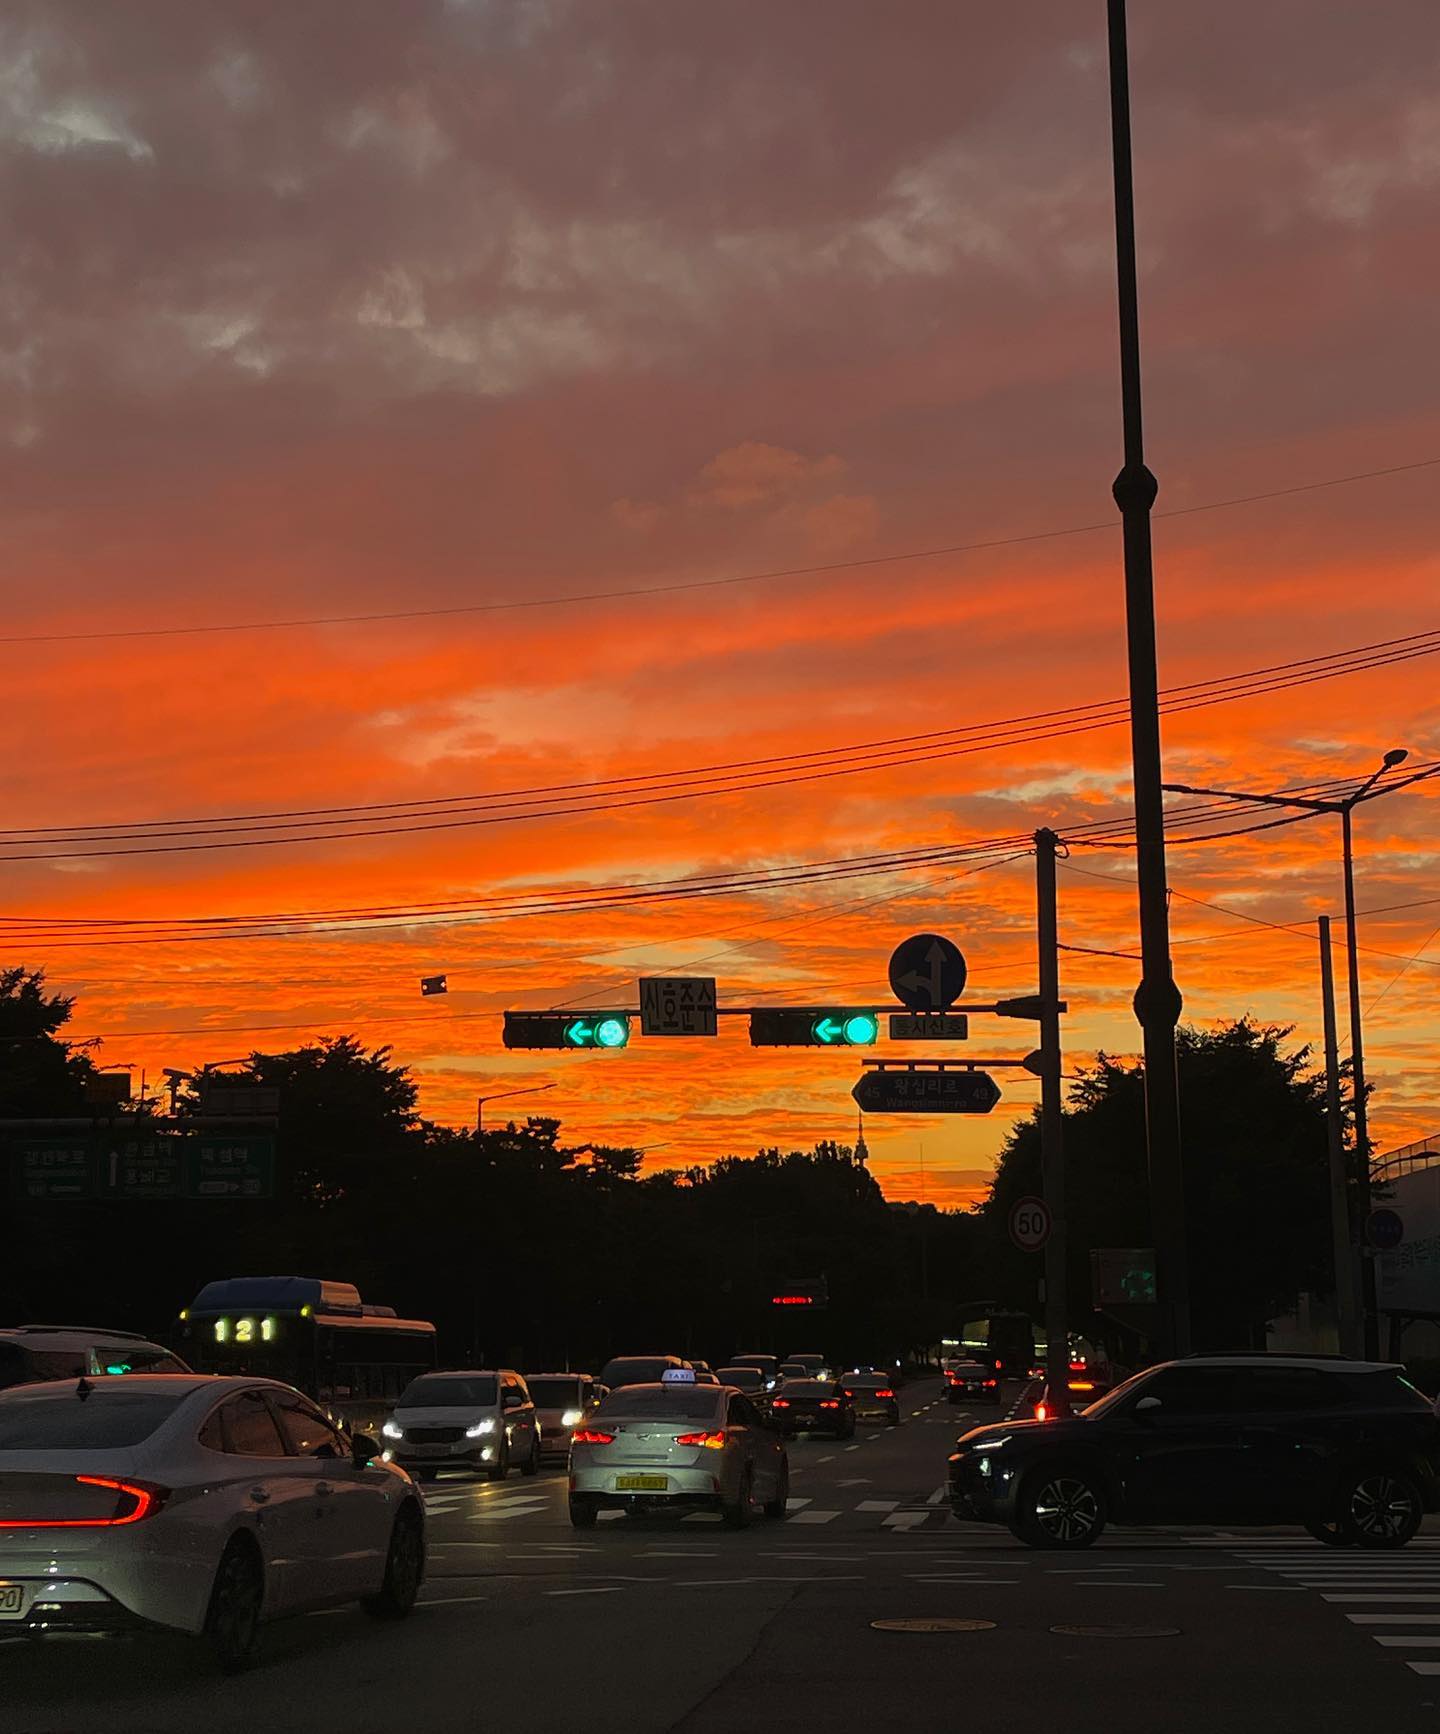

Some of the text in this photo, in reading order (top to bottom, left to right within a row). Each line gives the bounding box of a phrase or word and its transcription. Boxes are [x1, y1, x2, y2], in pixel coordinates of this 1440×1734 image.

[645, 982, 713, 1032] 신호준수
[864, 1087, 881, 1099] 45
[894, 1077, 960, 1096] 왕십리로
[1019, 1213, 1043, 1234] 50
[215, 1318, 273, 1342] 121
